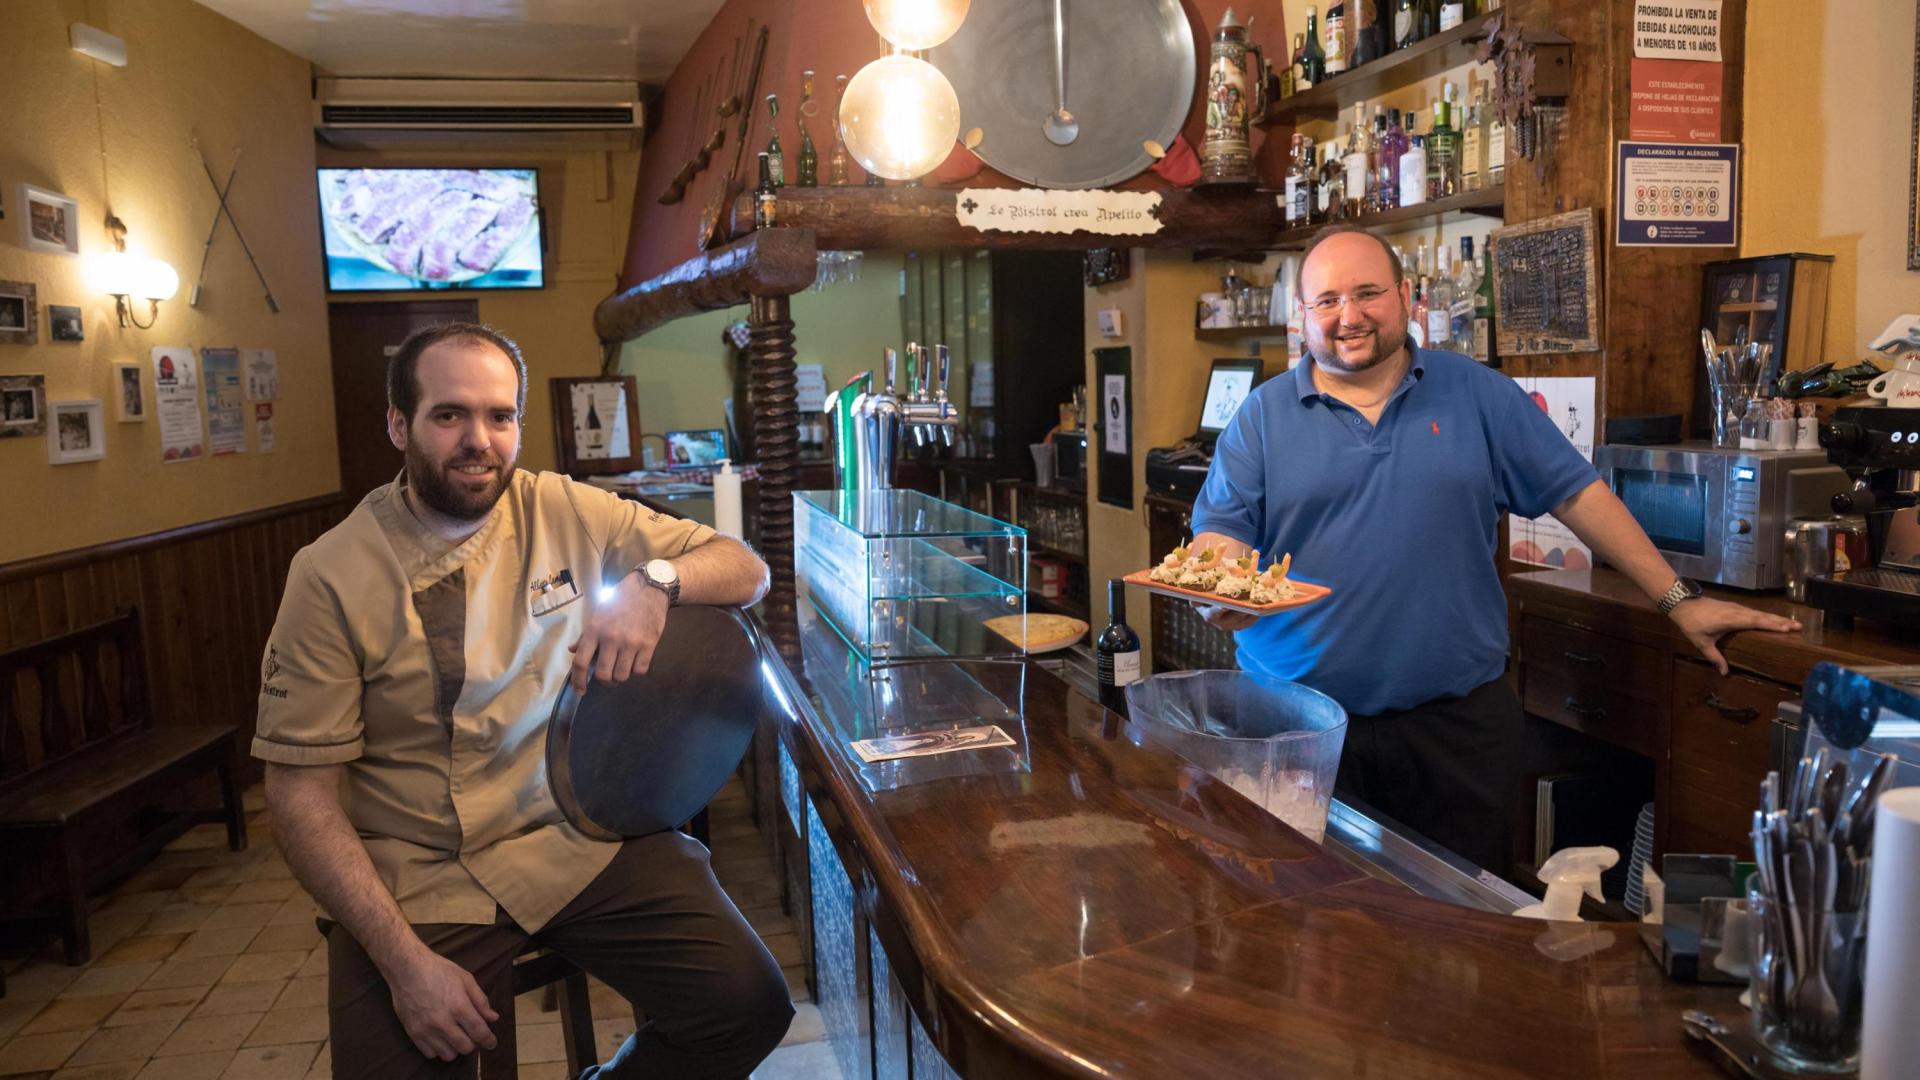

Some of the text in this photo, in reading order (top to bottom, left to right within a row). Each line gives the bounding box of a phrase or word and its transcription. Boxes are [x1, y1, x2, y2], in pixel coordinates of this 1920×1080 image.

[1638, 5, 1717, 20] PROHIBIDA LA VENTA DE
[1637, 21, 1717, 36] BEBIDAS ALCOHOLICAS
[1637, 38, 1717, 52] A MENORES DE 18 AÑOS
[1637, 148, 1676, 156] DECLARACIÓN
[988, 204, 1004, 215] Le
